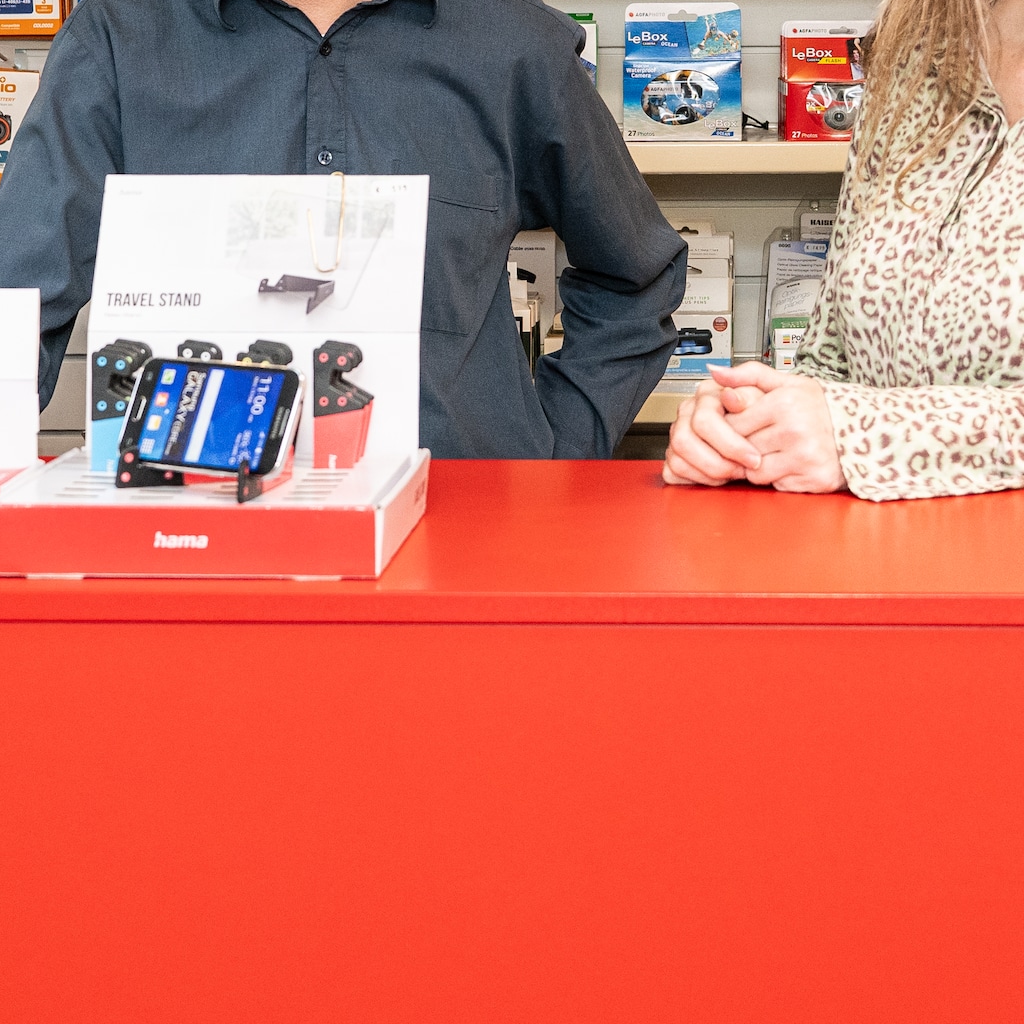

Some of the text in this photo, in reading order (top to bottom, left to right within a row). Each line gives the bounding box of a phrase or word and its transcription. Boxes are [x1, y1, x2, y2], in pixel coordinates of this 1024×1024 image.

[627, 31, 668, 44] LeBox
[792, 47, 833, 60] LeBox
[704, 119, 737, 129] LeBox
[107, 292, 201, 307] TRAVEL STAND
[153, 531, 209, 550] hama
